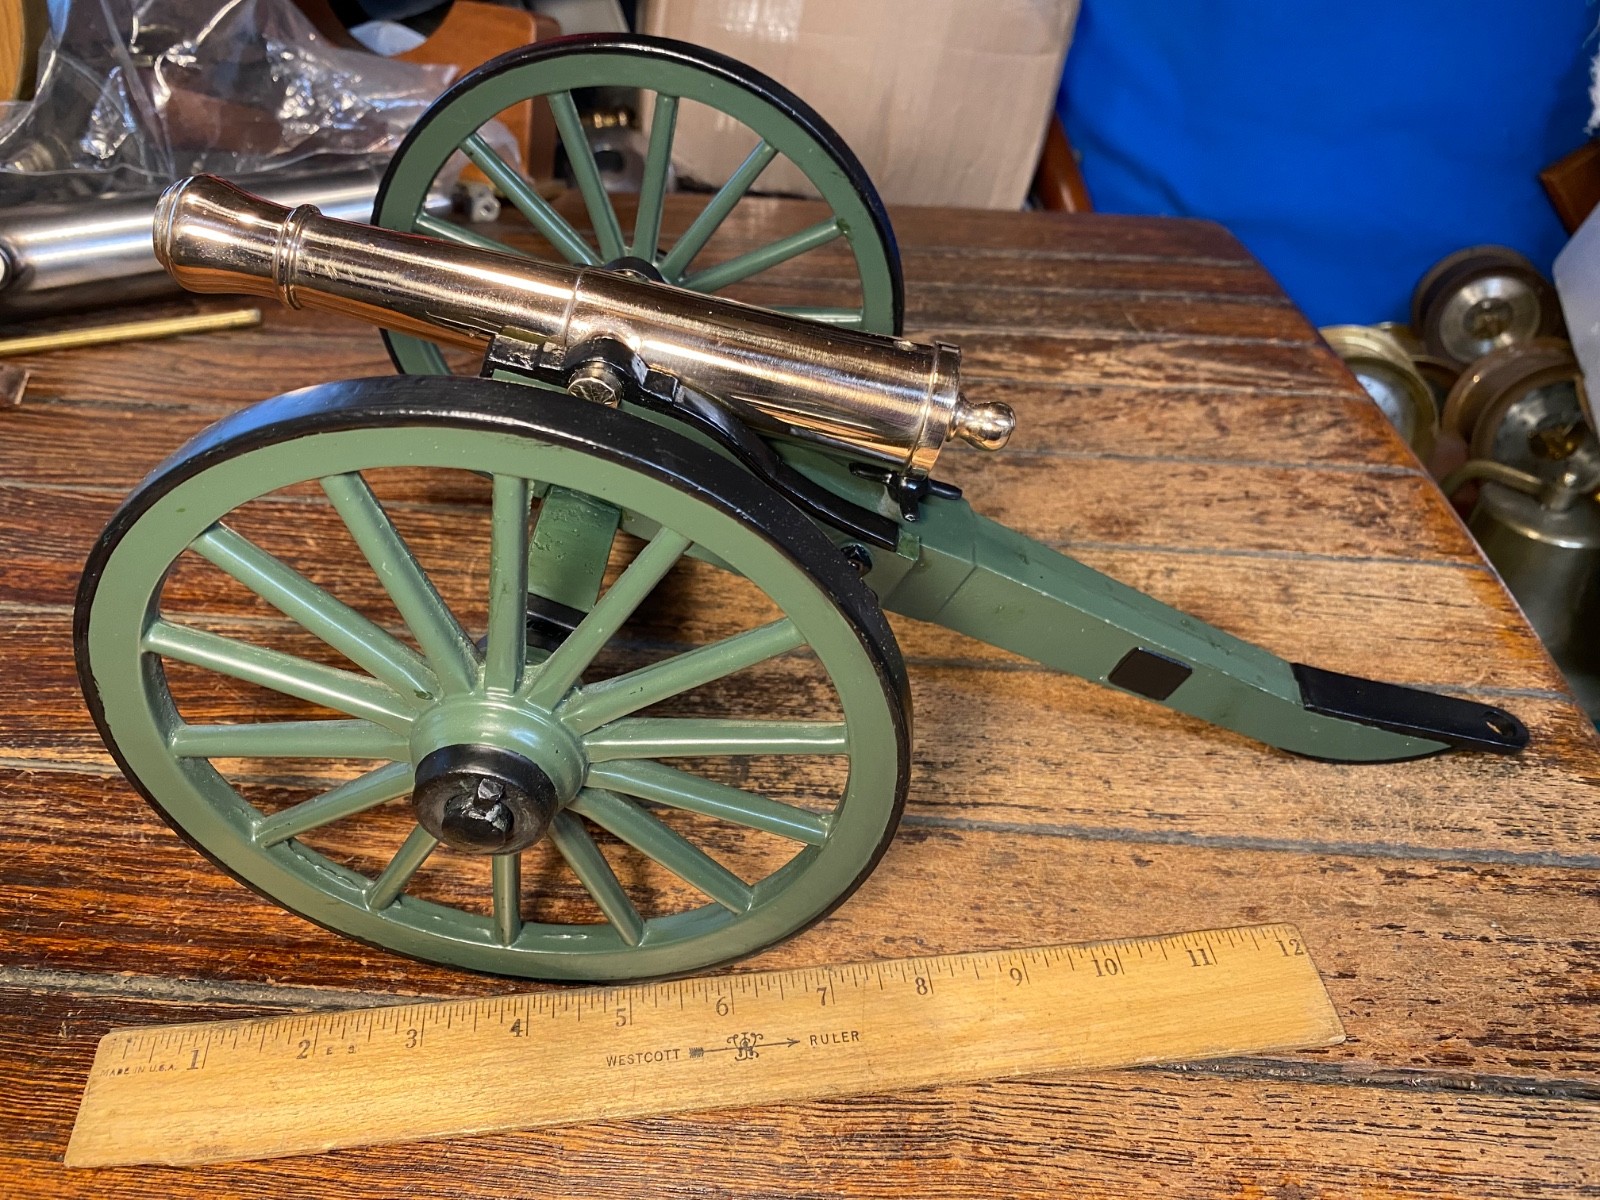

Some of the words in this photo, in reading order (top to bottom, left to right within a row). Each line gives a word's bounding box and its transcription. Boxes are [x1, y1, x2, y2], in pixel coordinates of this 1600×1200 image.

[187, 1049, 199, 1070] 1
[296, 1040, 311, 1059] 2
[405, 1029, 418, 1048] 3
[509, 1018, 523, 1038] 4
[615, 1007, 628, 1028] 5
[715, 997, 729, 1017] 6
[816, 986, 828, 1007] 7
[915, 976, 929, 996] 8
[1009, 967, 1023, 987] 9
[1094, 958, 1119, 978] 10
[1187, 948, 1214, 968] 11
[1278, 938, 1304, 958] 12
[606, 1048, 680, 1067] WESTCOTT
[809, 1030, 860, 1046] RULER
[134, 1065, 144, 1074] IN
